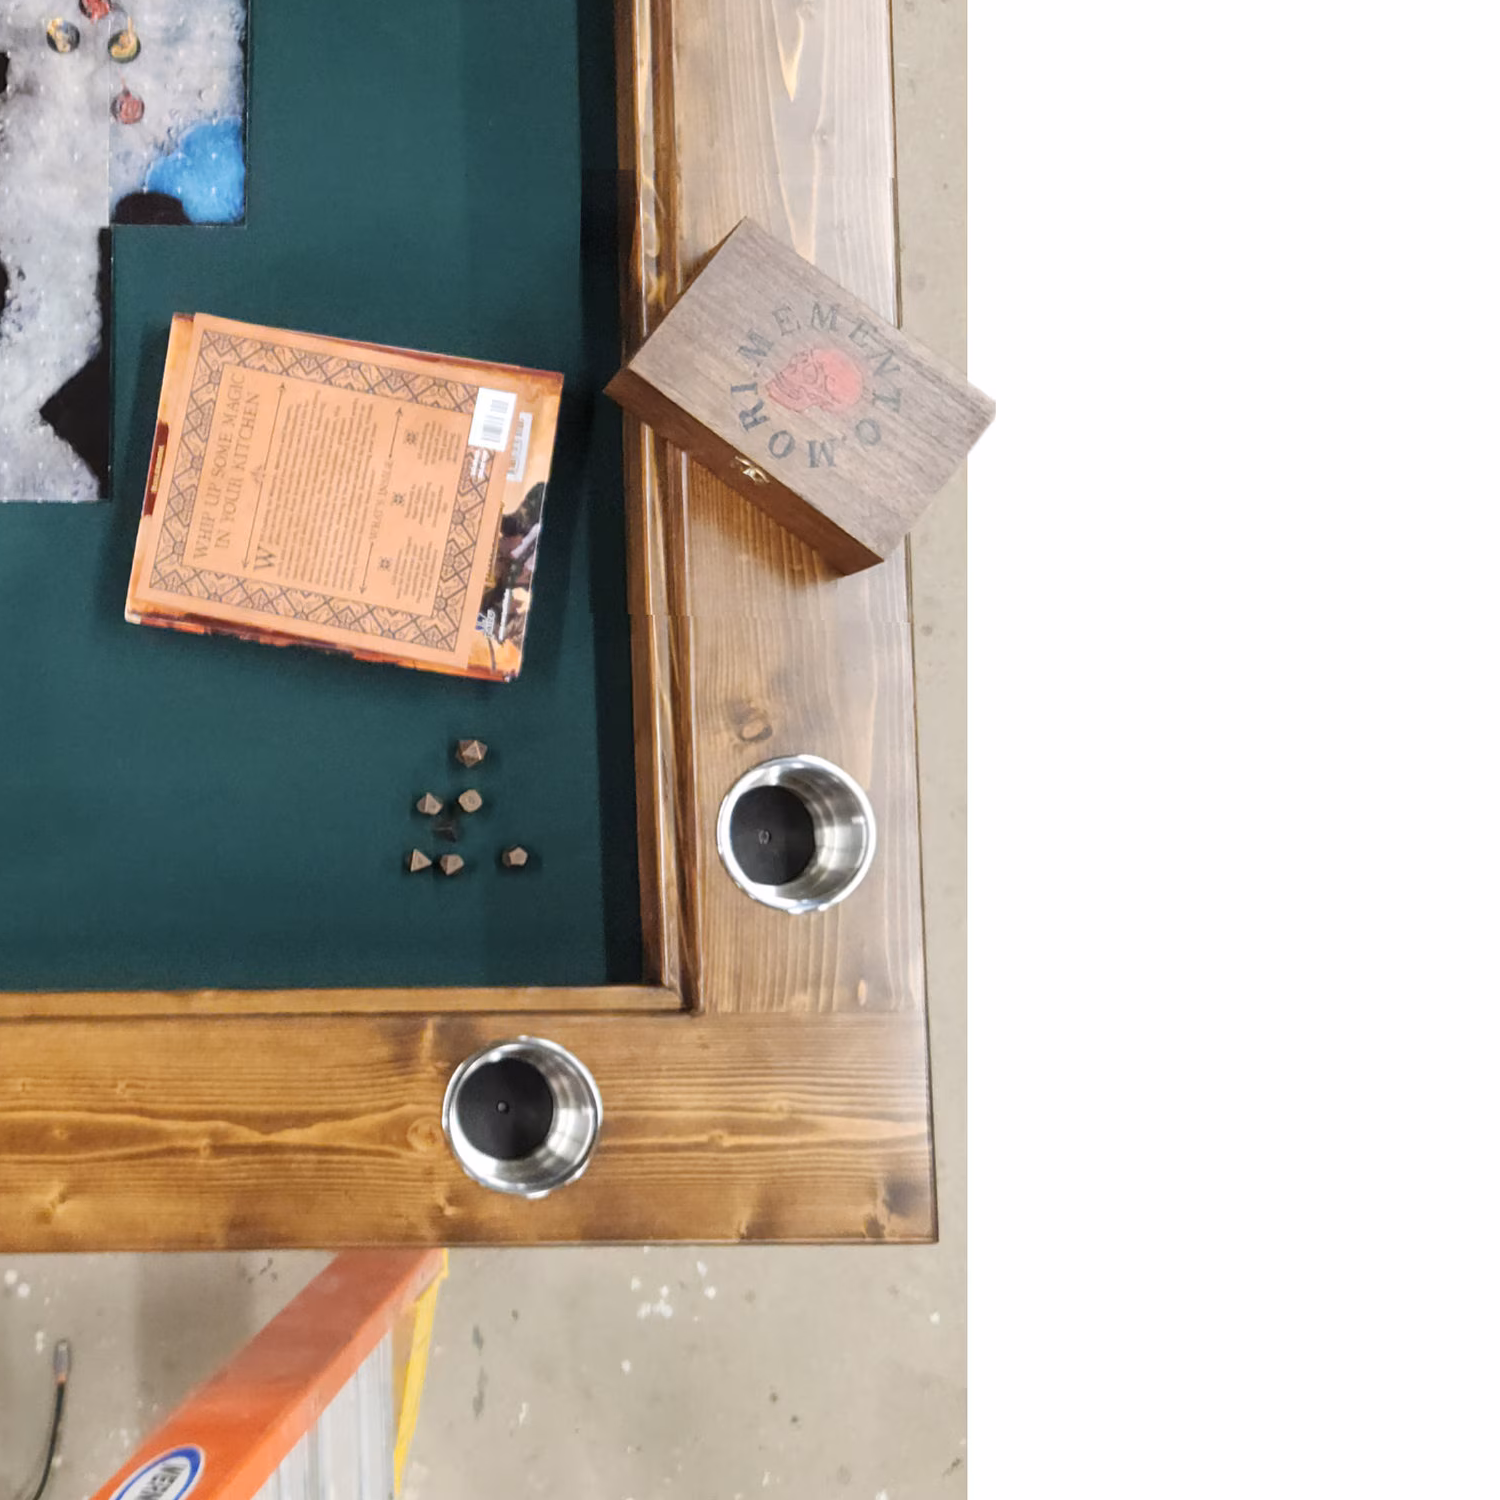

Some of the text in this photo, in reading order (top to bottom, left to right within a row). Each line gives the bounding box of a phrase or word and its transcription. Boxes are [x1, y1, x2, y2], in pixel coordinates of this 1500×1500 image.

[193, 373, 245, 559] WHIP UP SOME MAGIC
[215, 392, 260, 549] IN YOUR KITCHEN
[730, 384, 838, 468] MORI
